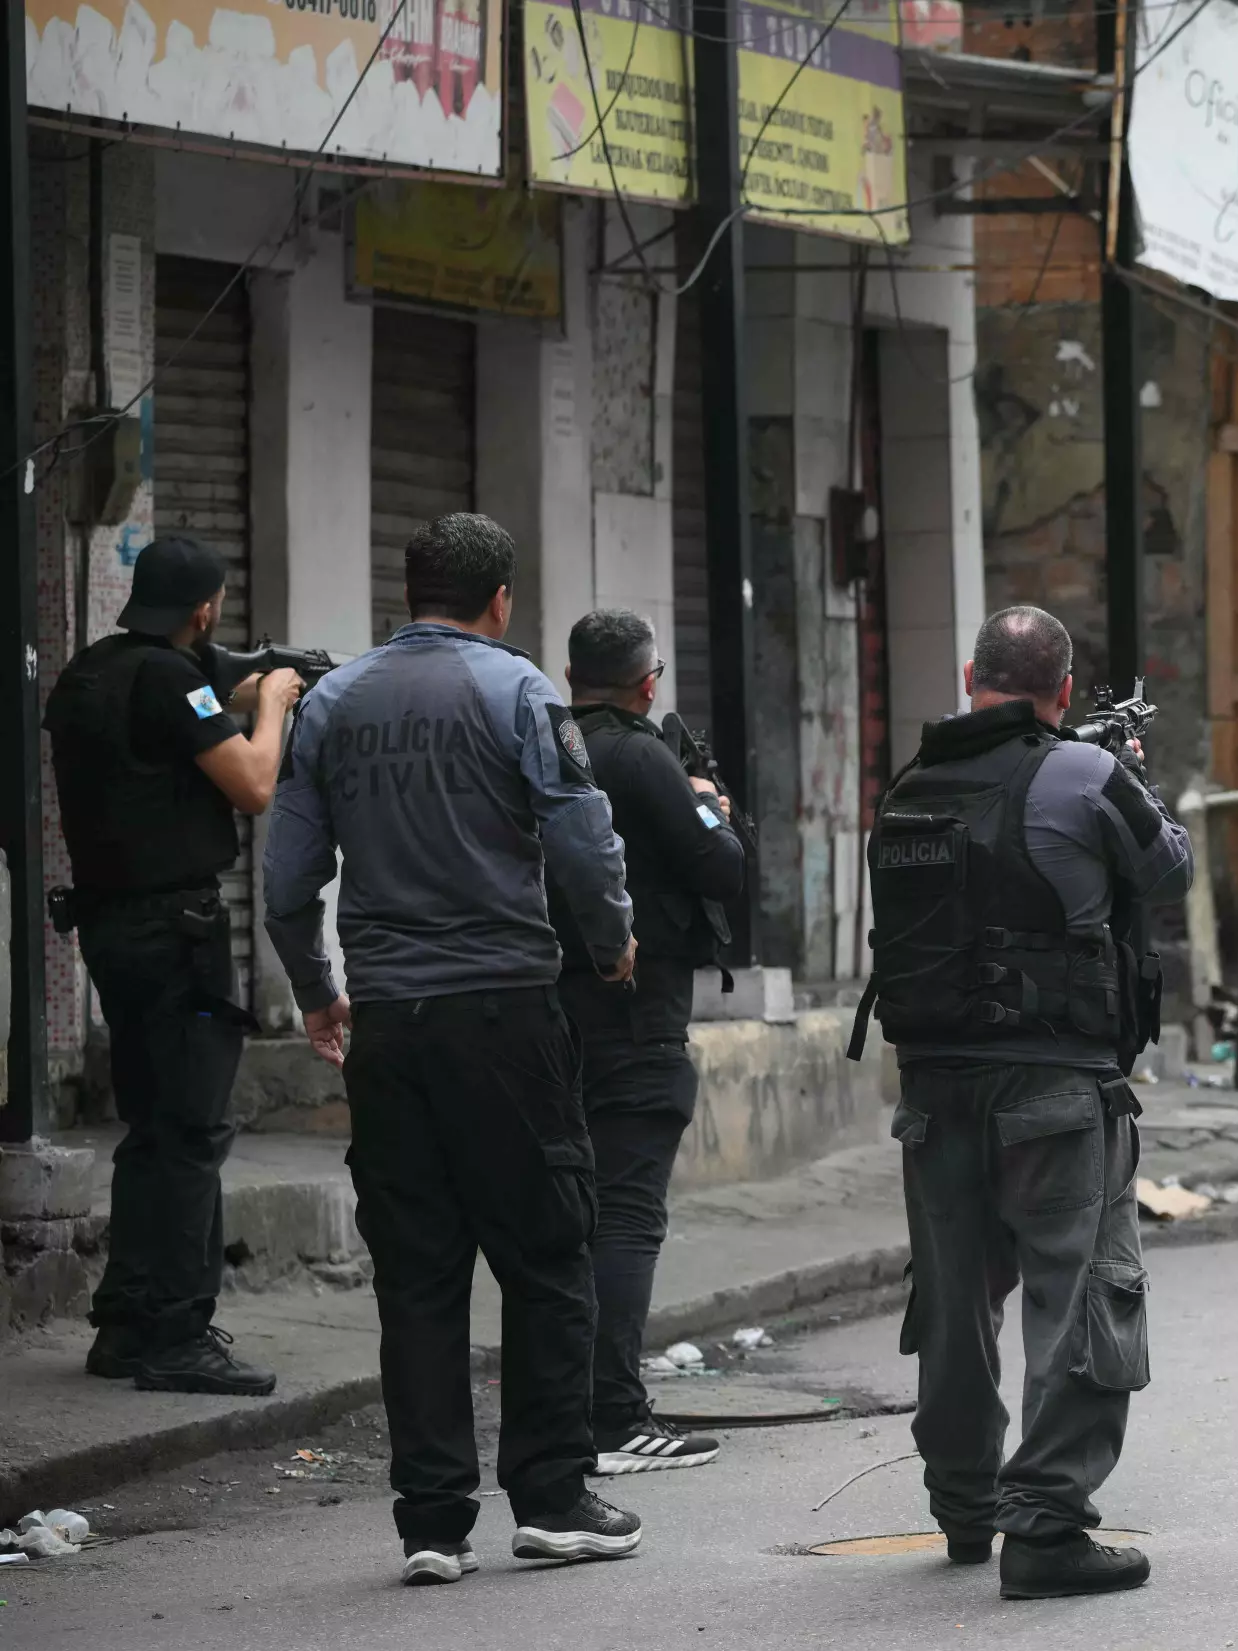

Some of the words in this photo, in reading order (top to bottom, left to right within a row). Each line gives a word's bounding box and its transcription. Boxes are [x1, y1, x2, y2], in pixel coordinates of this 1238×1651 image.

[336, 709, 470, 759] POLÍCIA
[341, 757, 474, 801] CIVIL
[882, 839, 950, 865] POLÍCIA
